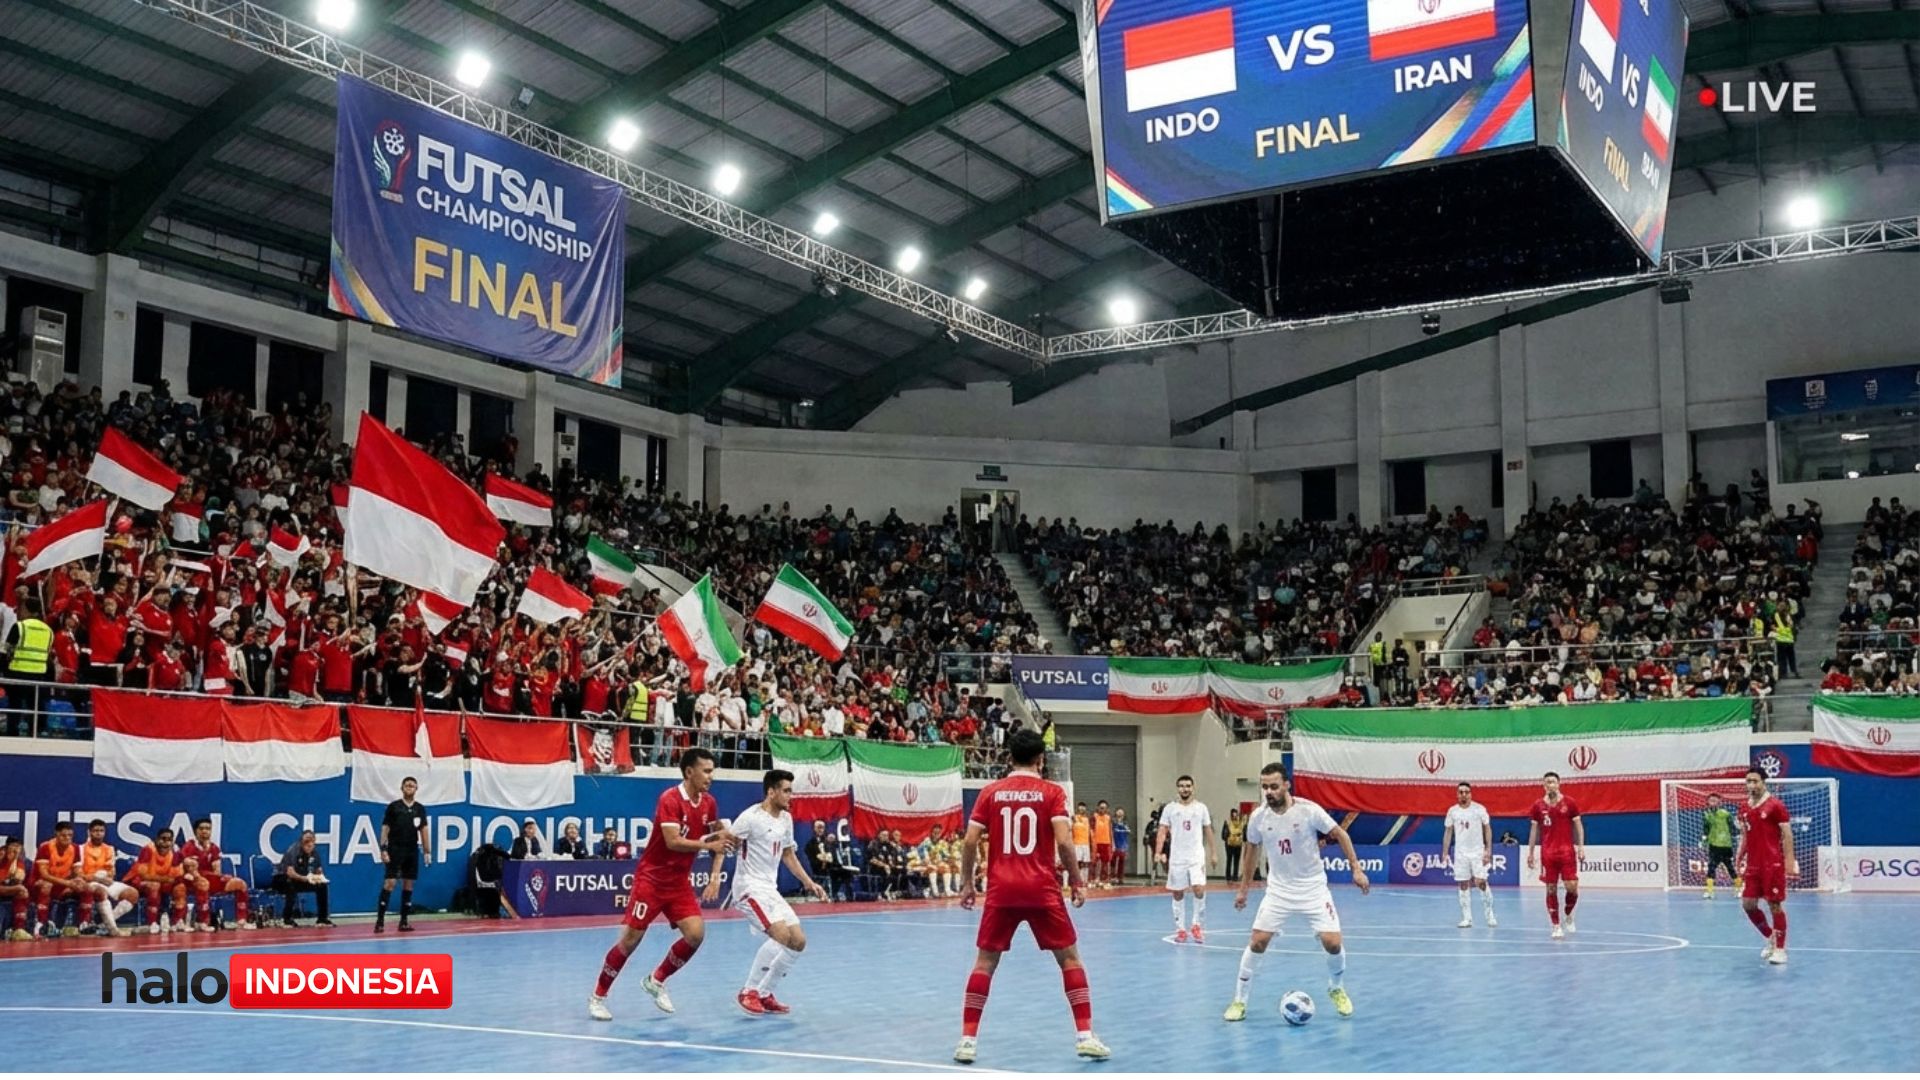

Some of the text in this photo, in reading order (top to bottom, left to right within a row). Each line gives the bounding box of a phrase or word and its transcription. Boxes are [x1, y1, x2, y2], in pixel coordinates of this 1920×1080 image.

[1267, 24, 1335, 71] VS
[1394, 54, 1473, 93] IRAN
[1622, 53, 1640, 108] VS
[1145, 107, 1220, 143] INDO
[1255, 113, 1360, 158] FINAL
[417, 134, 576, 232] FUTSAL
[416, 185, 592, 263] CHAMPIONSHIP
[413, 236, 578, 338] FINAL
[258, 812, 653, 865] CHAPIONSHIP
[1000, 806, 1037, 855] 10
[555, 873, 618, 892] FUTSAL
